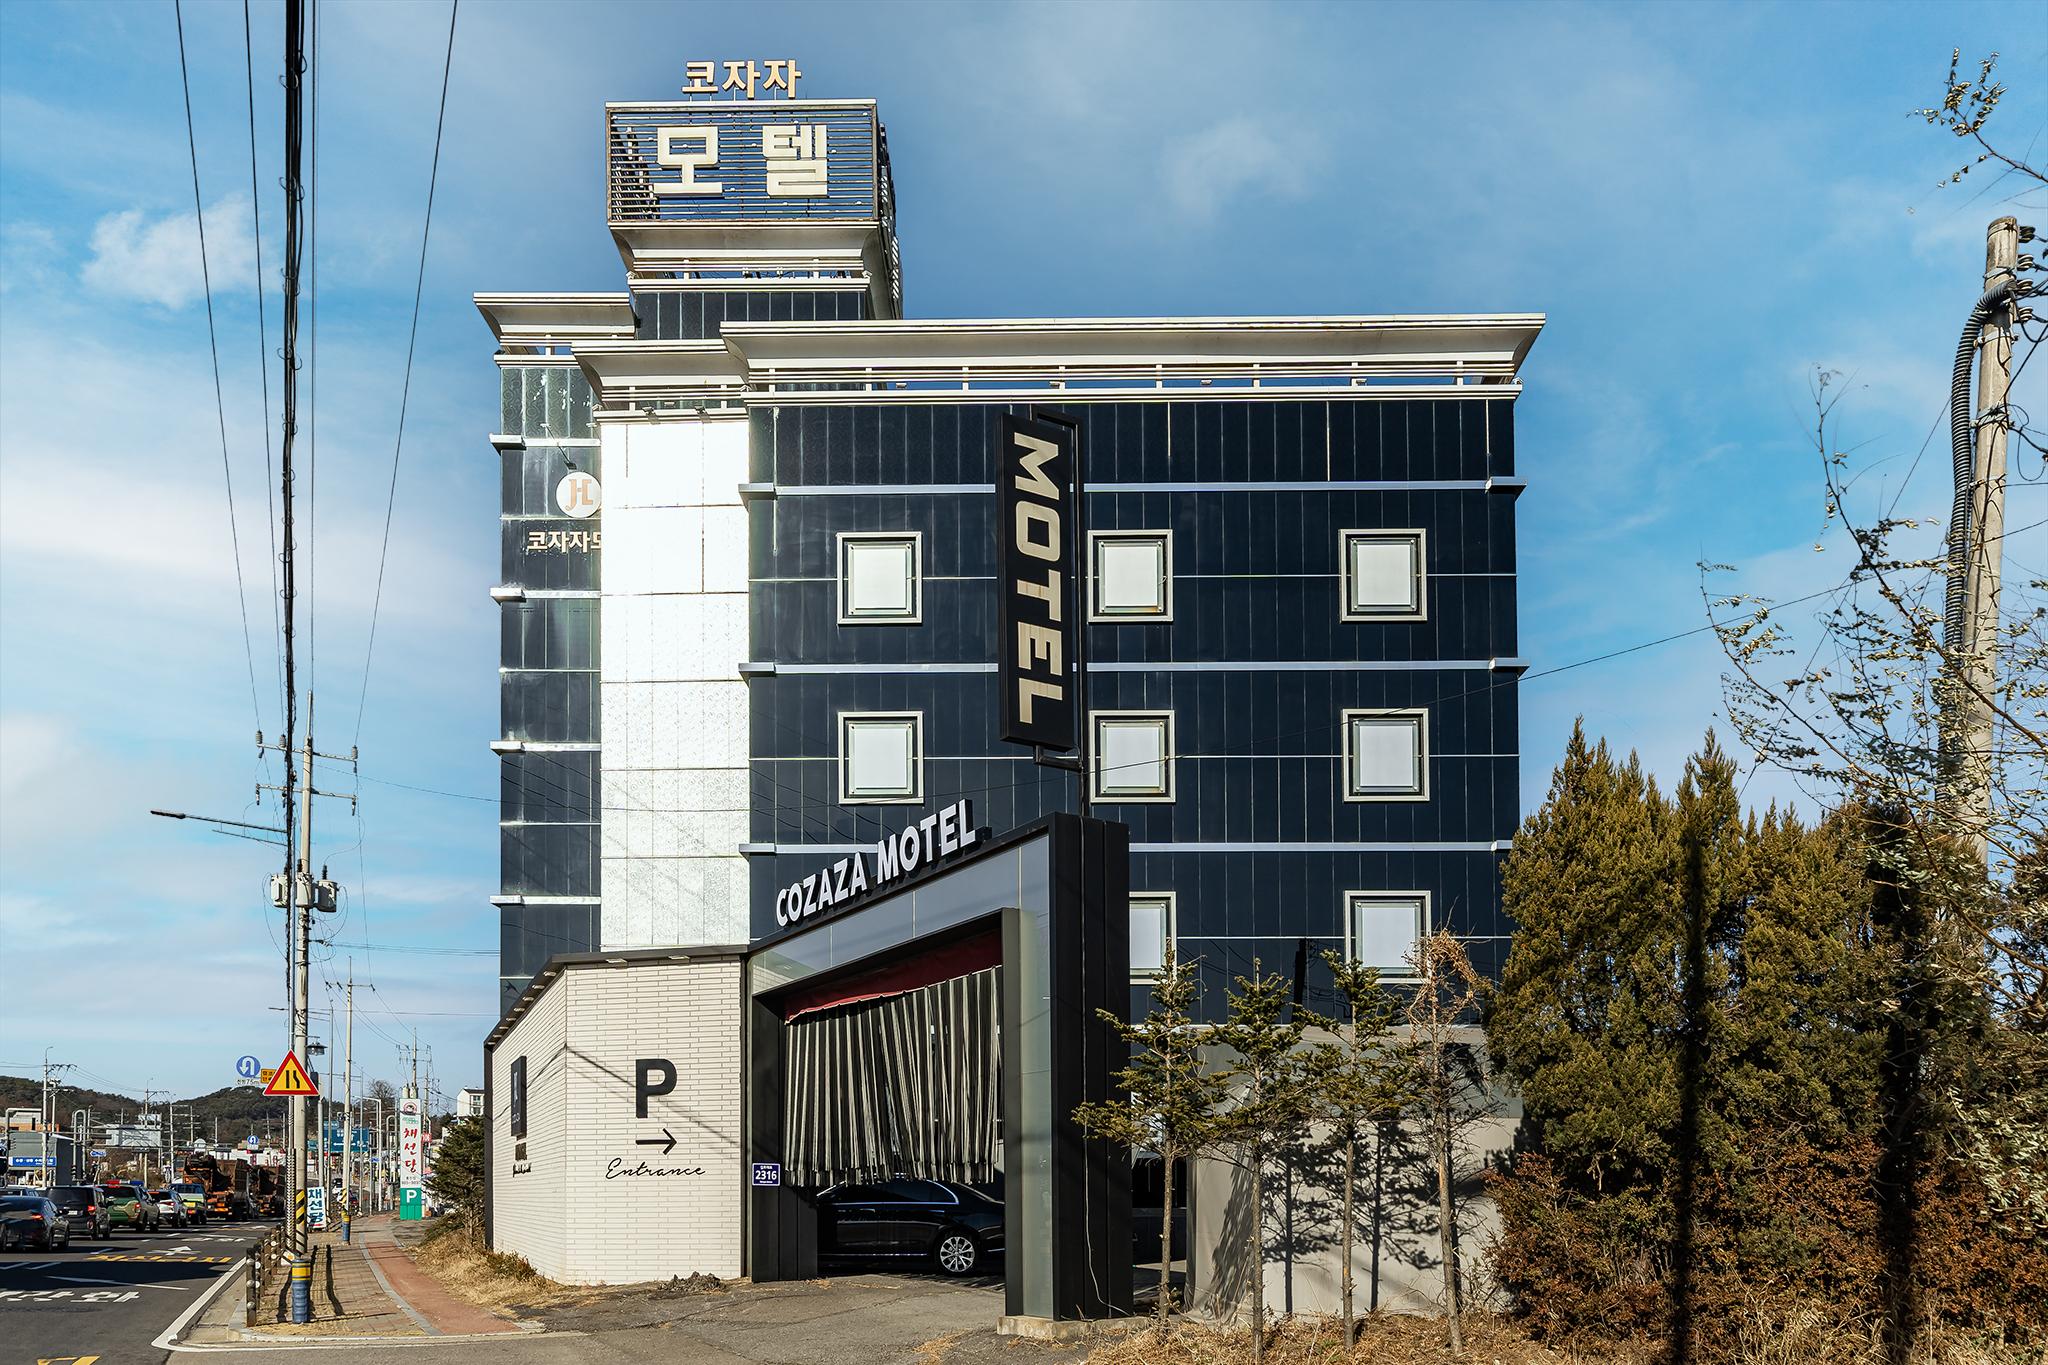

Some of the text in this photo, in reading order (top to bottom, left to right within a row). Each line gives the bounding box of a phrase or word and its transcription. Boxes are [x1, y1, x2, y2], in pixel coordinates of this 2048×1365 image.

[682, 59, 802, 99] 코자자
[653, 124, 828, 198] 모텔
[1014, 432, 1063, 725] MOTEL
[776, 799, 977, 927] COZAZA MOTEL
[635, 1058, 678, 1119] P
[404, 1127, 418, 1173] 채선당
[605, 1158, 706, 1180] Entrance
[406, 1189, 417, 1203] P
[755, 1170, 777, 1180] 2316
